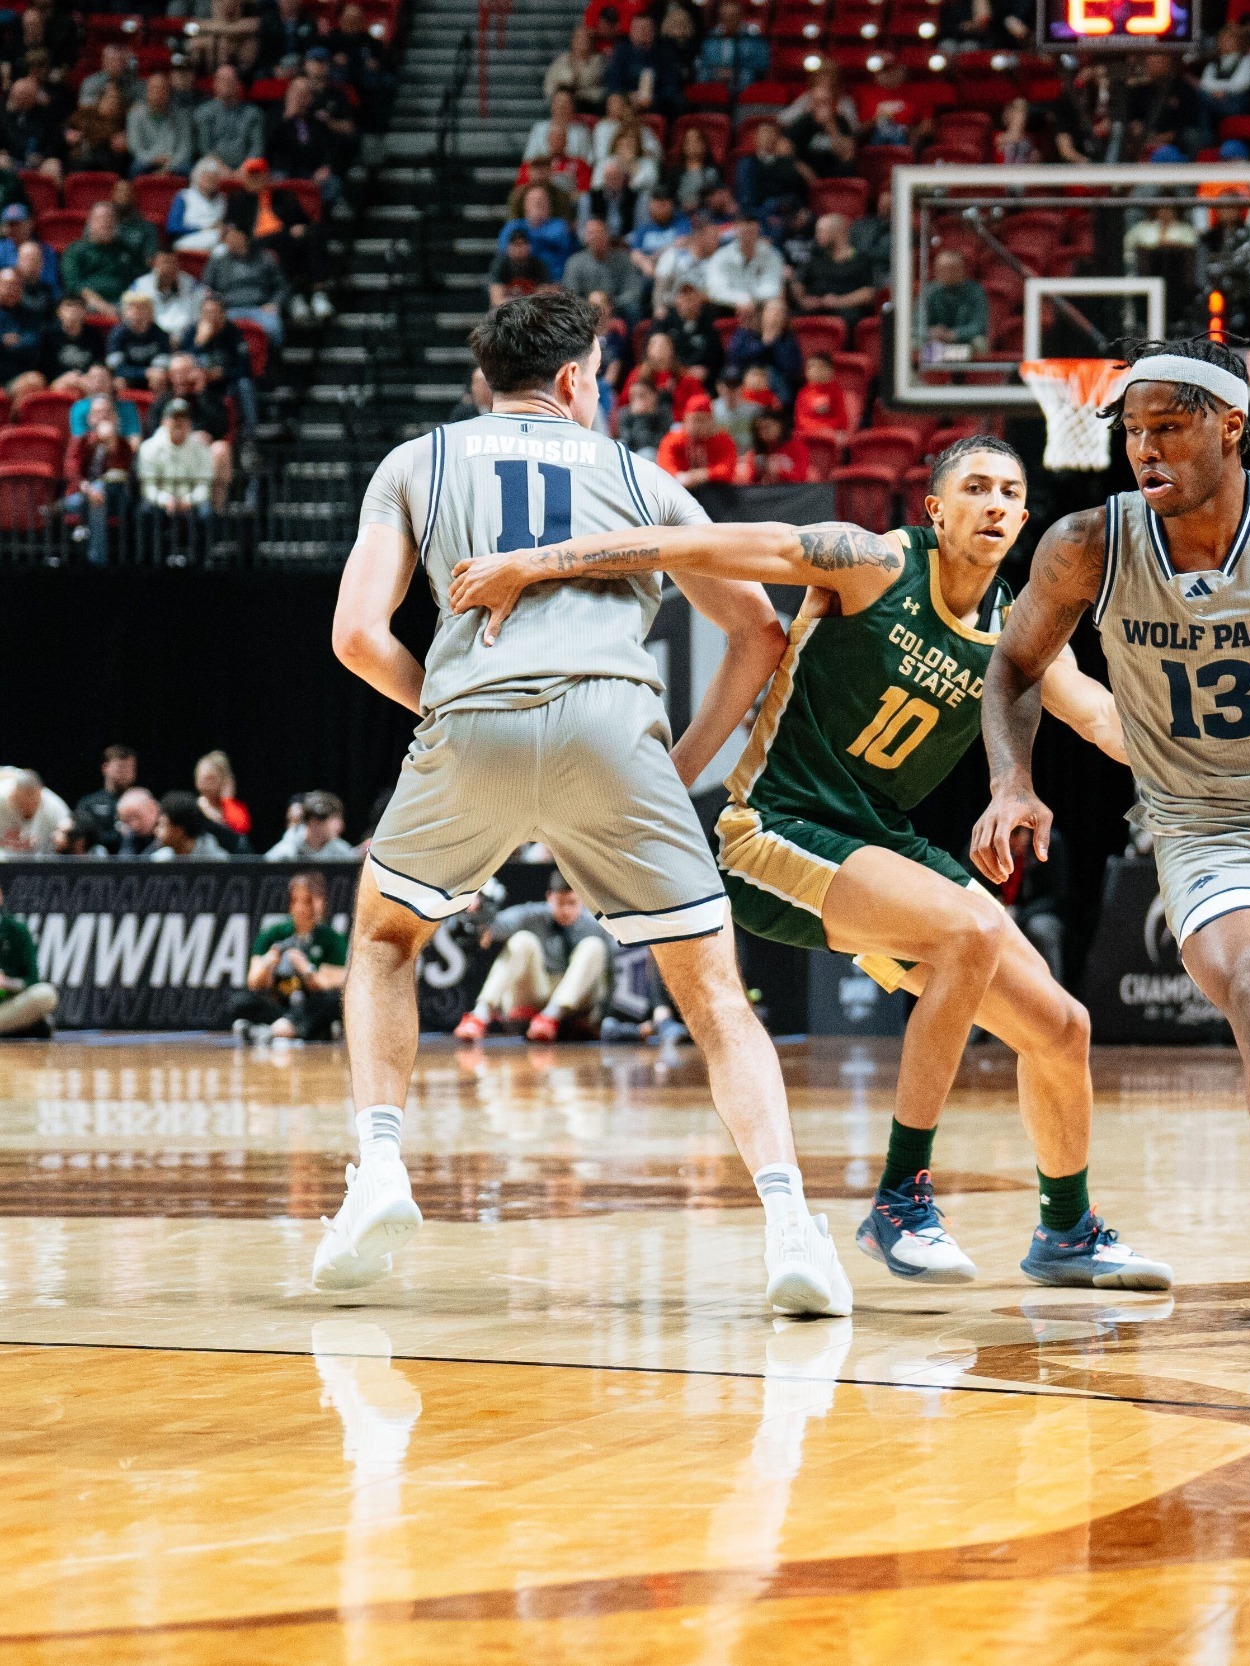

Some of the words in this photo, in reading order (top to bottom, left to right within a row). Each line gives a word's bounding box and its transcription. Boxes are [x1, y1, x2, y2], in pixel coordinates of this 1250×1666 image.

[465, 434, 597, 465] DAVIDSON
[494, 460, 573, 553] 11
[888, 623, 985, 700] COLORAD
[1122, 618, 1206, 651] WOLF
[898, 654, 967, 709] STATE
[846, 685, 940, 770] 10
